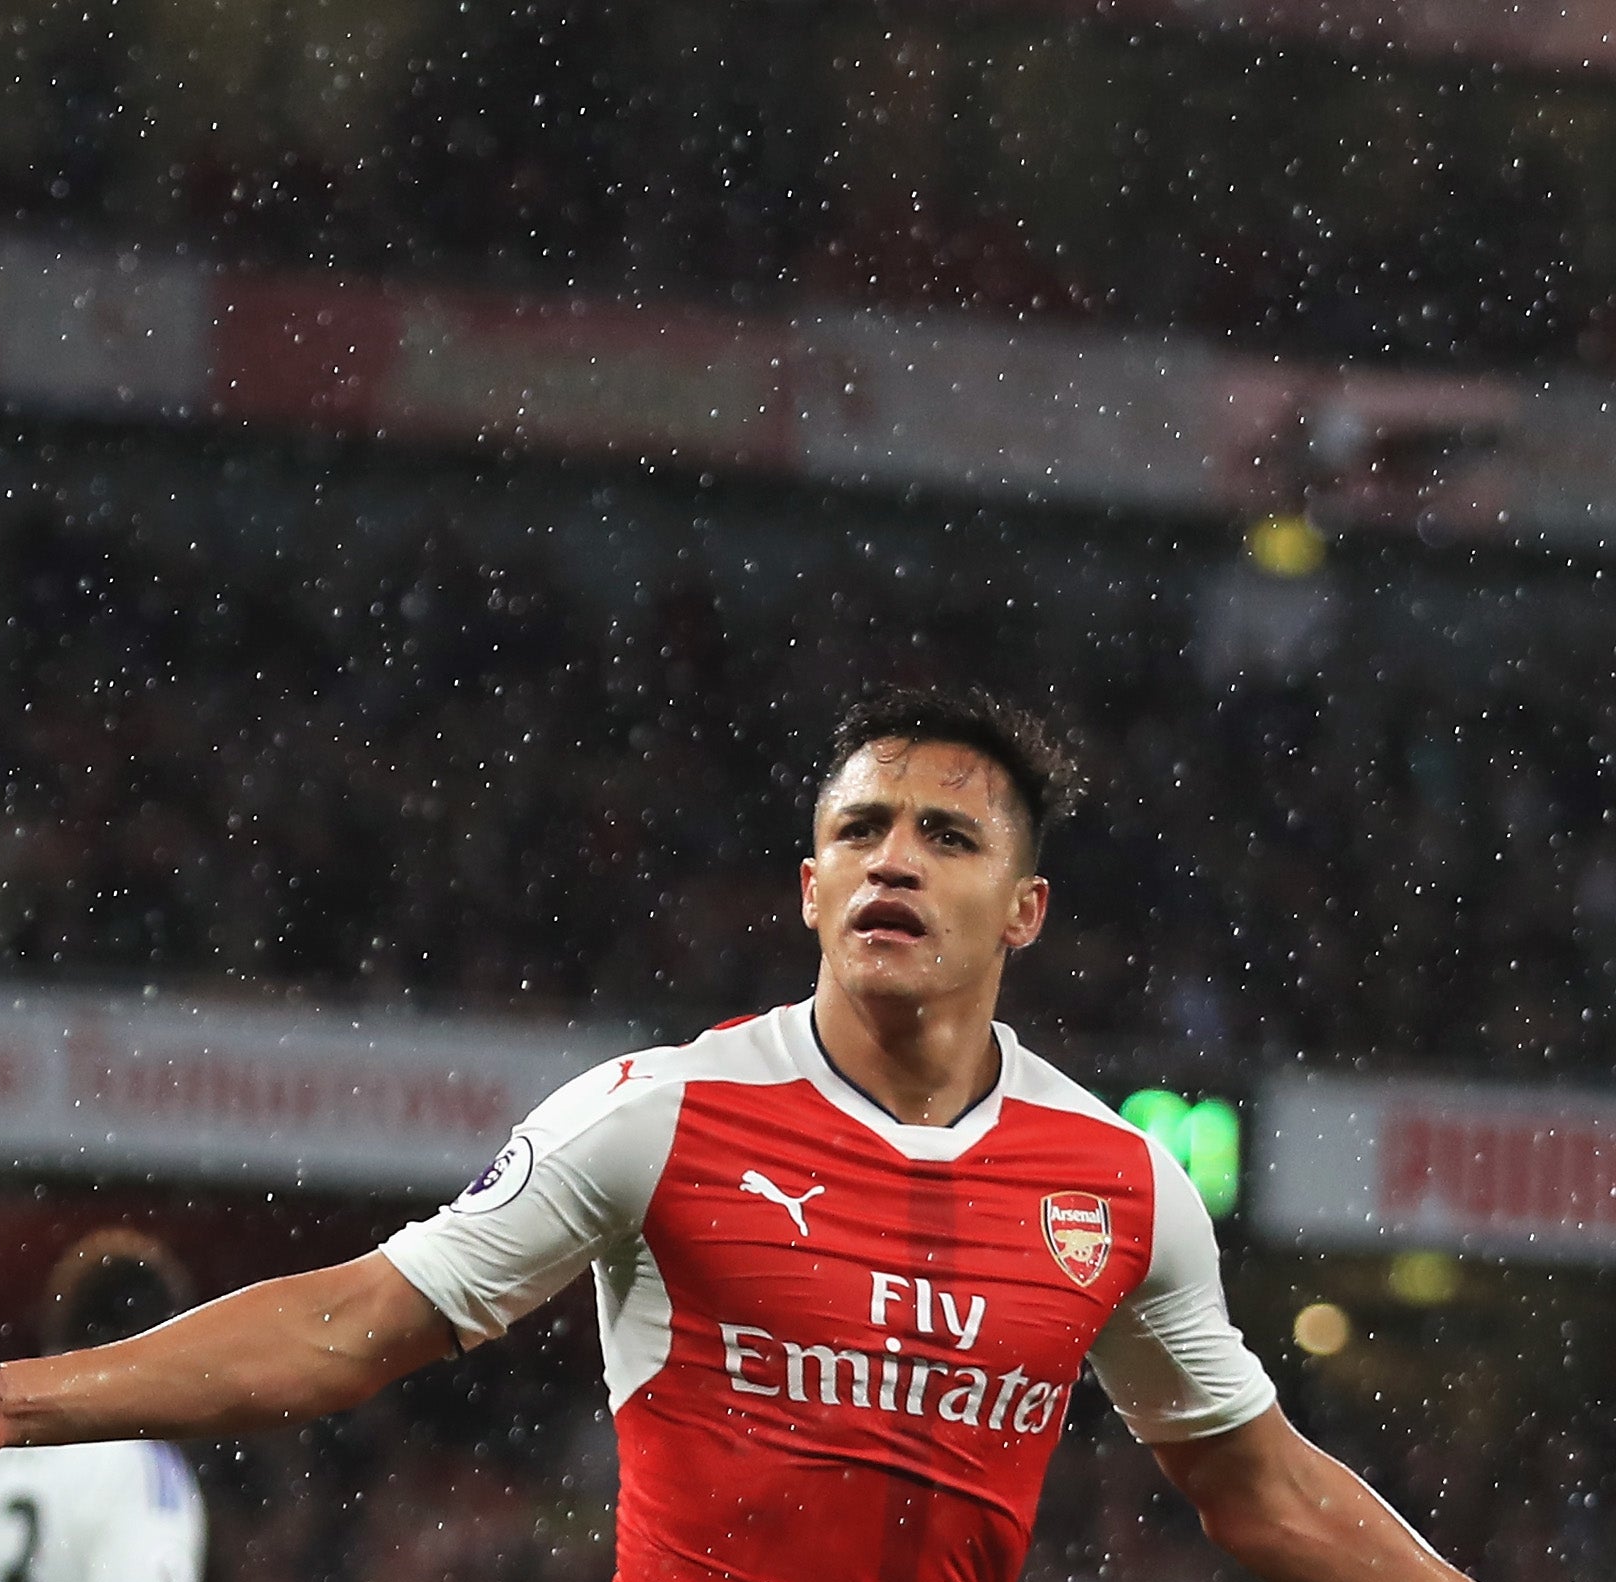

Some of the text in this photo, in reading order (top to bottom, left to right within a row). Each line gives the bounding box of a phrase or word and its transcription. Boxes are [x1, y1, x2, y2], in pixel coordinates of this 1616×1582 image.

[1050, 1205, 1102, 1225] Arsenal
[869, 1270, 987, 1351] Fly
[719, 1321, 1064, 1436] Emirates
